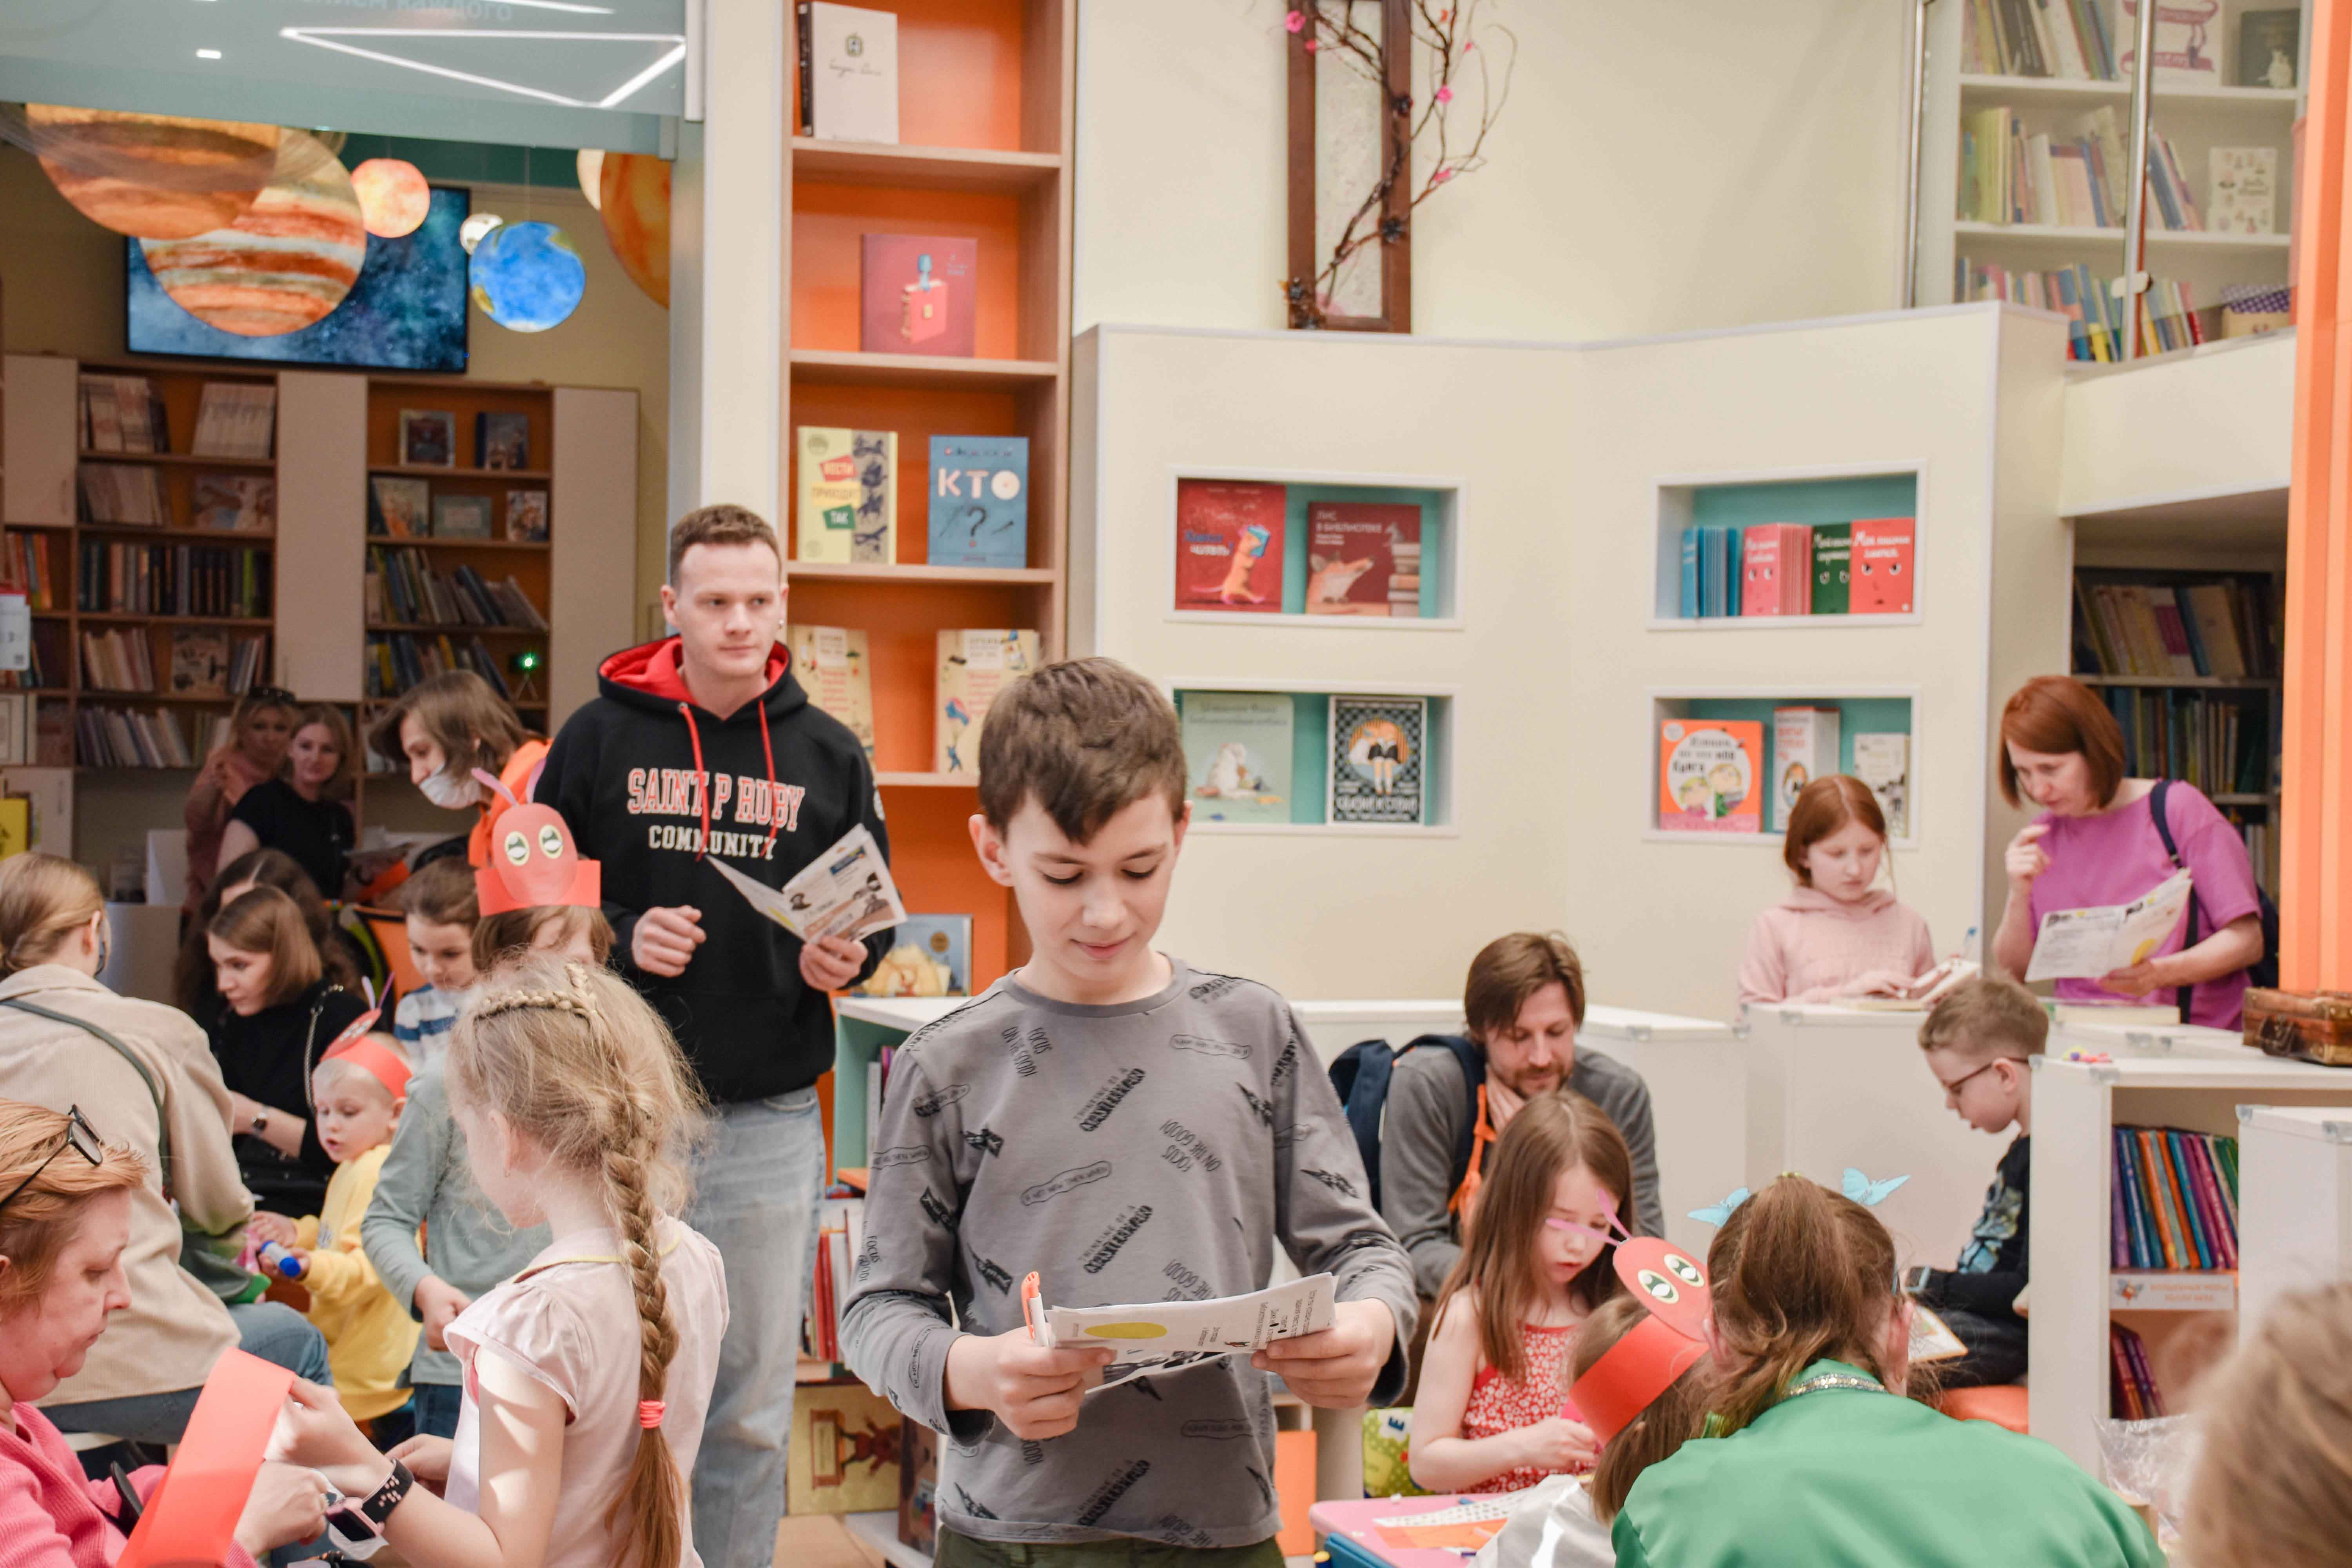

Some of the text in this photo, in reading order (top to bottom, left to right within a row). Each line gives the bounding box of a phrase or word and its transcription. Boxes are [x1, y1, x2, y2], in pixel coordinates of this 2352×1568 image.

[937, 467, 1021, 501] КТО
[830, 511, 849, 524] ТАК
[627, 768, 806, 832] SAINT P RUBY
[648, 824, 777, 860] COMMUNITY
[1002, 1026, 1021, 1044] ON
[1027, 1027, 1053, 1054] FOCUS
[1159, 1118, 1196, 1146] GOOD!
[1161, 1144, 1193, 1172] FOCUS
[866, 1235, 881, 1263] FOCUS
[1162, 1258, 1199, 1288] GOOD!
